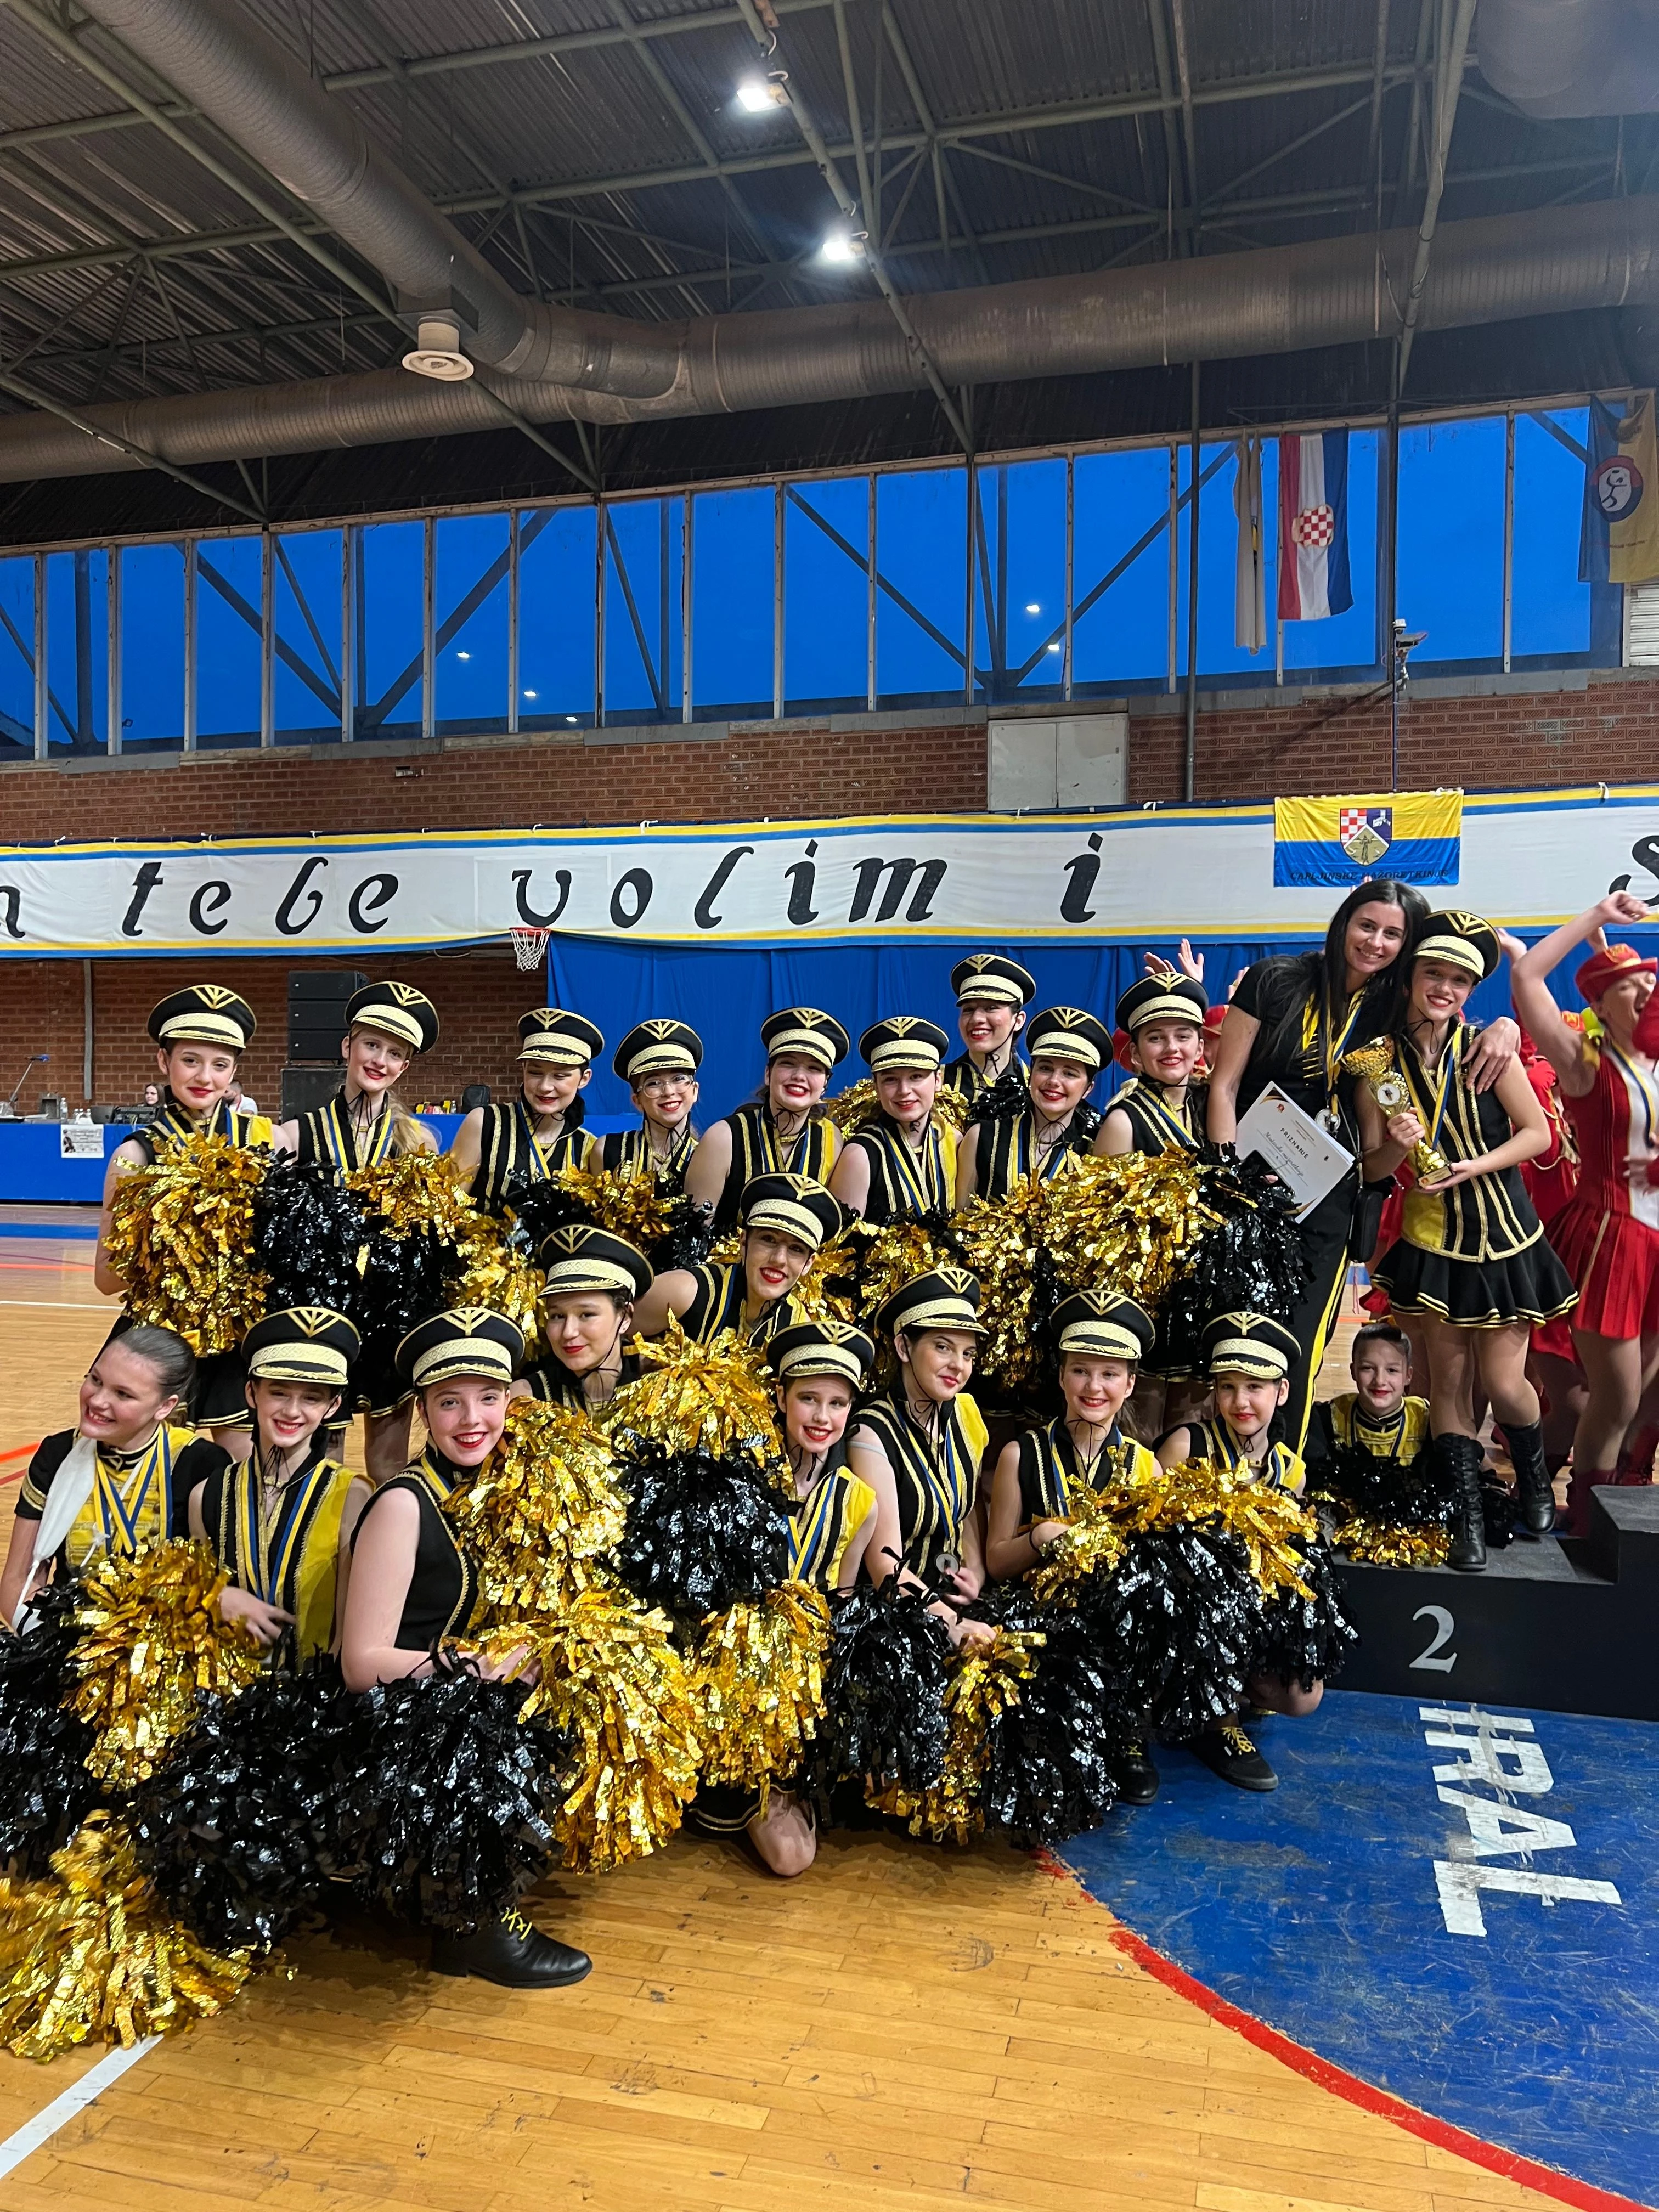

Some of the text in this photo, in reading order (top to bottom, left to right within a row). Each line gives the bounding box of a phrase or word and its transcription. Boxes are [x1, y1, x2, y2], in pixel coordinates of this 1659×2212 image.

[122, 856, 399, 936] tebe
[511, 839, 948, 928] volim
[1060, 832, 1103, 923] i
[1280, 1127, 1308, 1159] PRIZNANJE
[1409, 1605, 1457, 1673] 2
